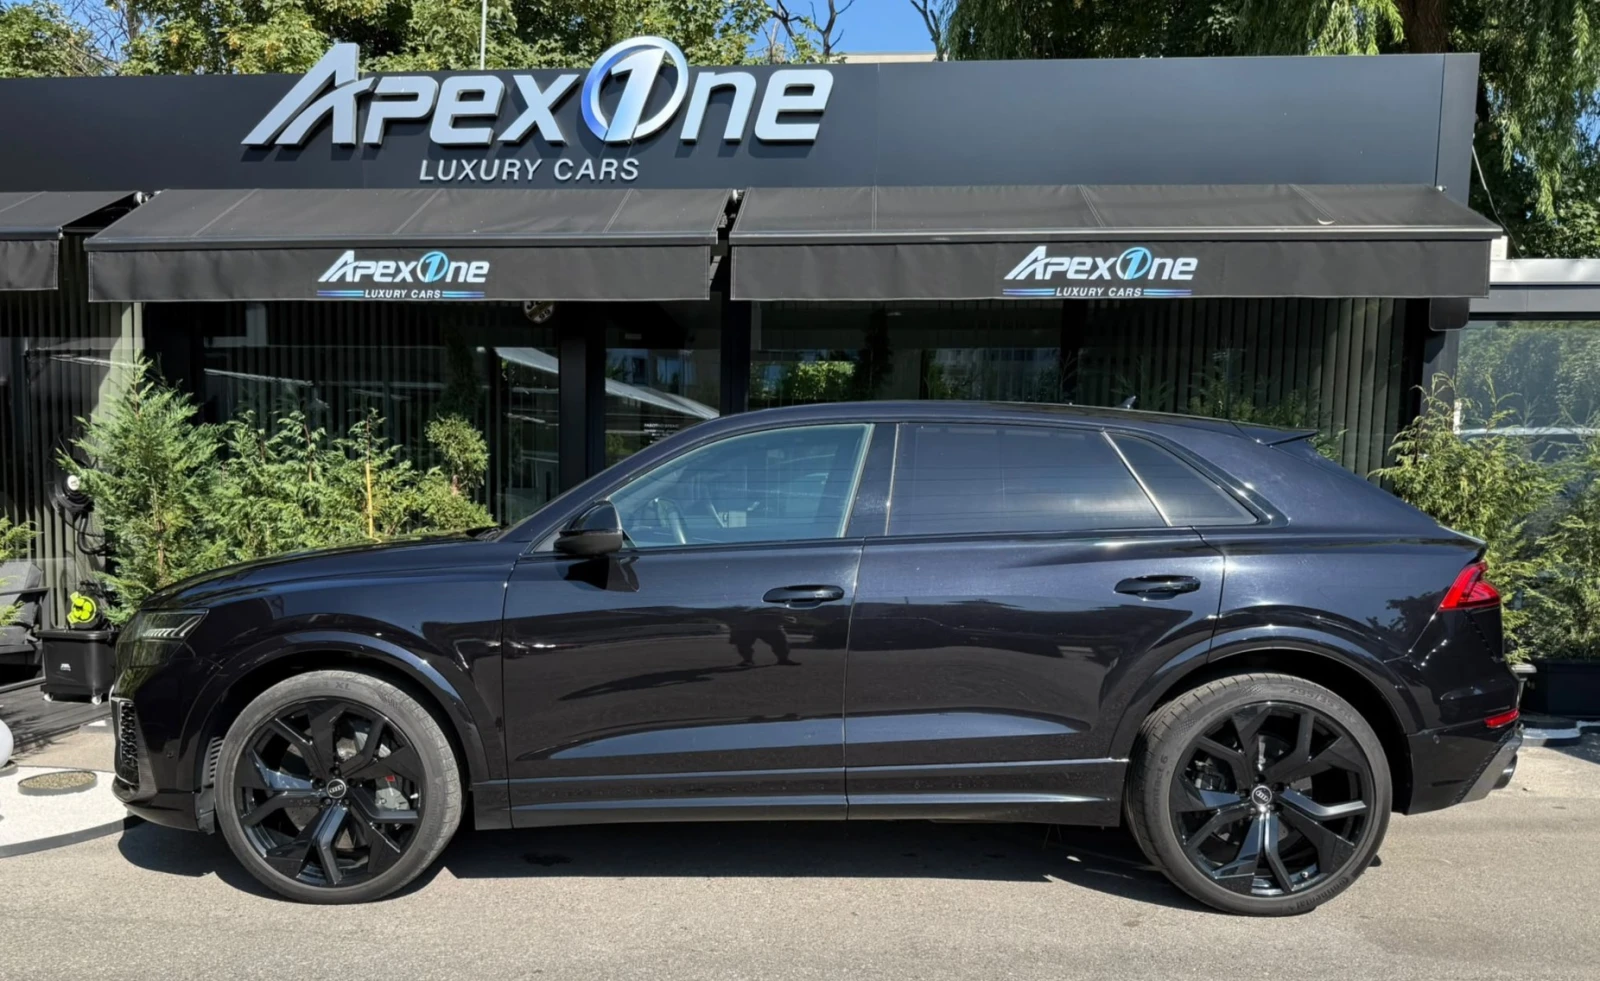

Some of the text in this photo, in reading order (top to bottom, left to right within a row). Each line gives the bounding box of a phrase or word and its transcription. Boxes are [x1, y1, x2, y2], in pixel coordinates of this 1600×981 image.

[419, 158, 640, 181] LUXURY CARS
[364, 289, 441, 299] LUXURY CARS
[1055, 287, 1142, 297] LUXURY CARS
